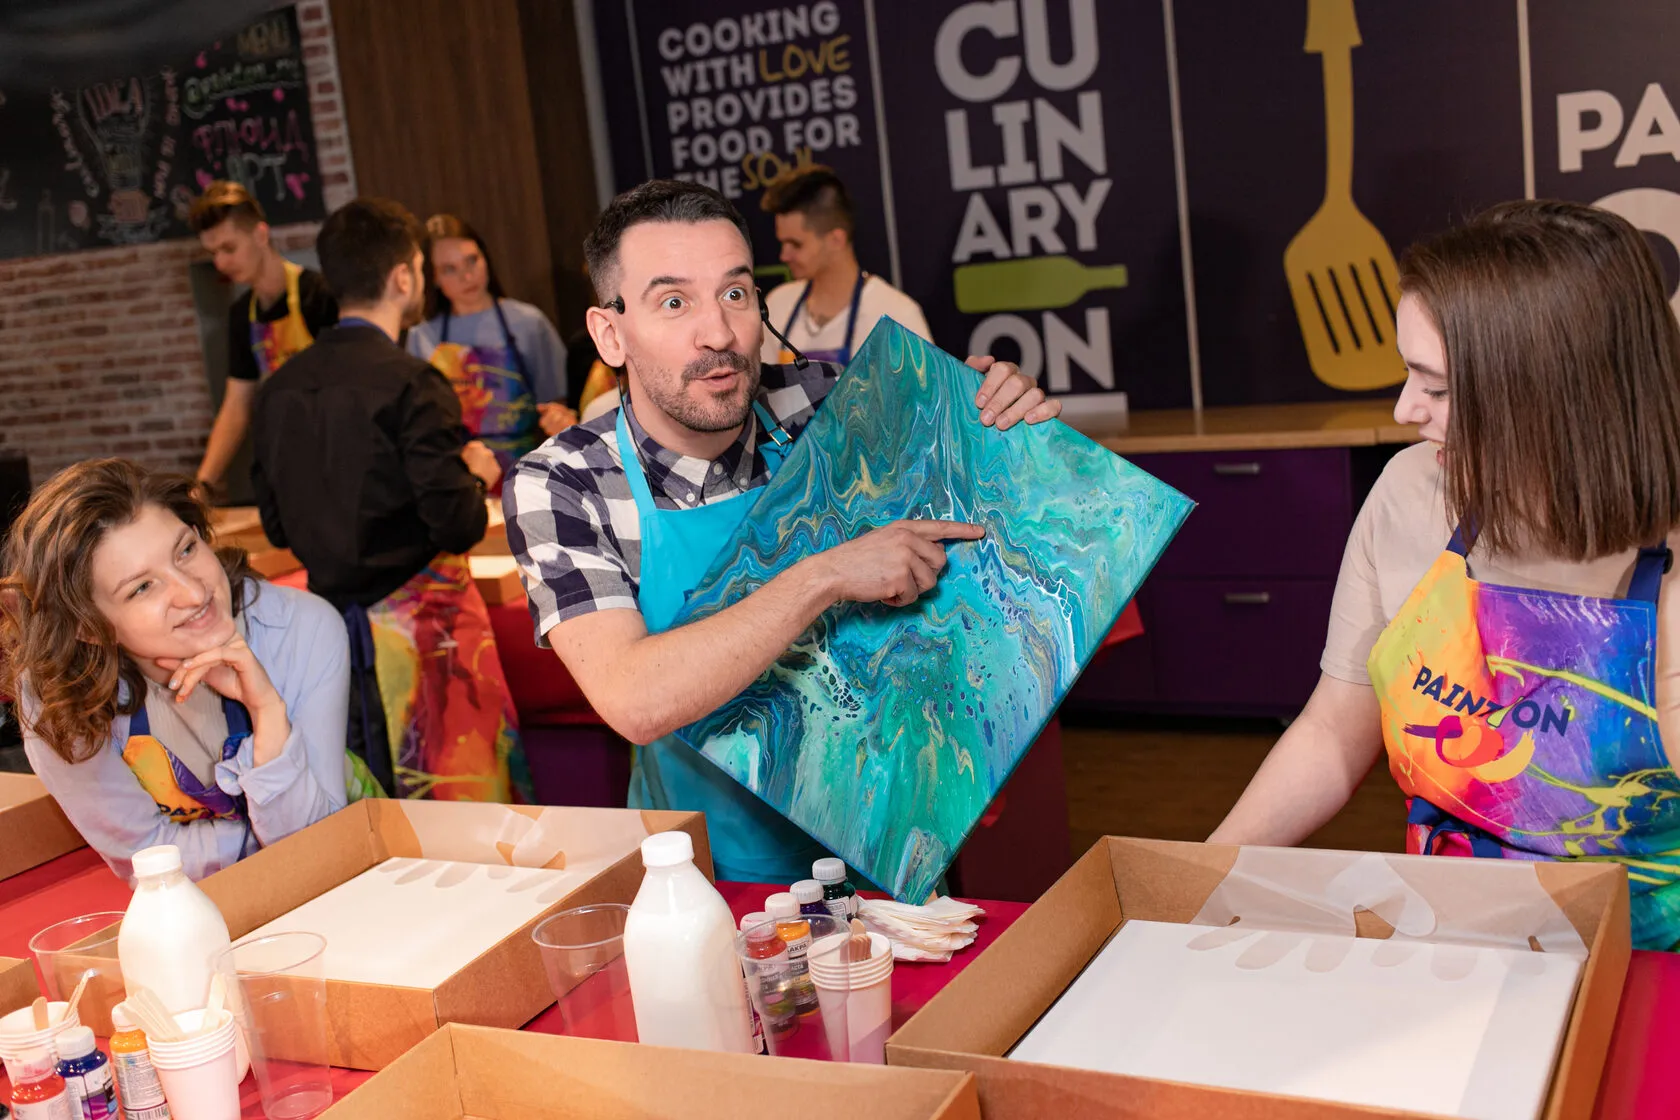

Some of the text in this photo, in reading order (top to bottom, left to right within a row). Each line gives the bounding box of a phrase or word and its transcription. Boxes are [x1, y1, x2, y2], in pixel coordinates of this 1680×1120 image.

[658, 1, 840, 61] COOKING
[660, 34, 851, 97] WITH LOVE
[934, 0, 1099, 102] CU
[666, 75, 858, 134] PROVIDES
[945, 90, 1107, 191] LIN
[1556, 82, 1680, 174] PA
[671, 113, 861, 170] FOOD FOR
[952, 179, 1113, 263] ARY
[967, 306, 1115, 392] ON
[1512, 699, 1571, 737] ON
